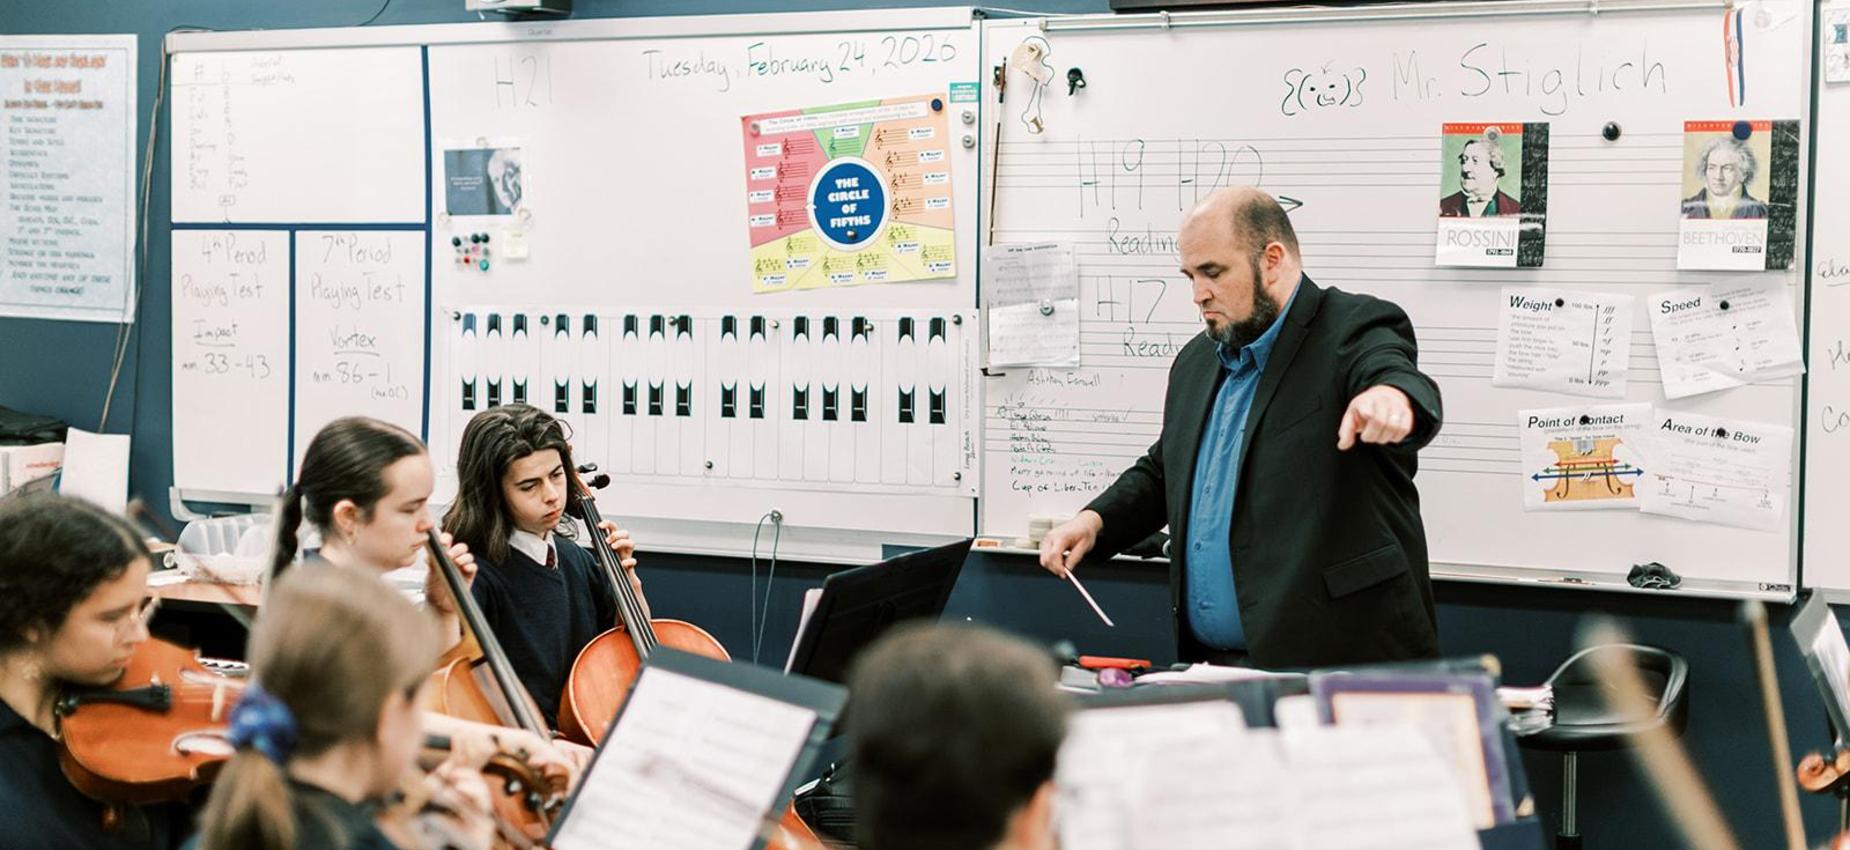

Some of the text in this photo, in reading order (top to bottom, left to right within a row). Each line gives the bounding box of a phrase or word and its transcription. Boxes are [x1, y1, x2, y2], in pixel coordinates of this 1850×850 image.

[642, 50, 740, 92] Tuesday,
[748, 42, 833, 83] February
[881, 34, 956, 65] 2026
[495, 55, 552, 108] H21
[1393, 39, 1666, 116] Mr. Stiglich
[835, 177, 859, 189] THE
[1078, 134, 1144, 218] H19
[828, 189, 869, 202] CIRCLE
[830, 214, 871, 229] FIFTHS
[841, 204, 857, 215] OF
[225, 233, 266, 264] Period
[349, 233, 392, 264] Period
[1447, 229, 1516, 248] ROSSINI
[1683, 232, 1763, 245] BEETHOVEN
[181, 273, 264, 308] Playing Test
[310, 271, 405, 310] Playing Test
[1096, 274, 1167, 325] H17
[1509, 295, 1553, 312] Weight
[1661, 297, 1701, 314] Speed
[193, 319, 238, 340] Impact
[329, 324, 377, 349] Vortex
[1528, 416, 1561, 429] Point
[1563, 416, 1576, 427] of
[1660, 418, 1692, 434] Area
[1695, 427, 1708, 436] of
[1733, 431, 1761, 444] Bow
